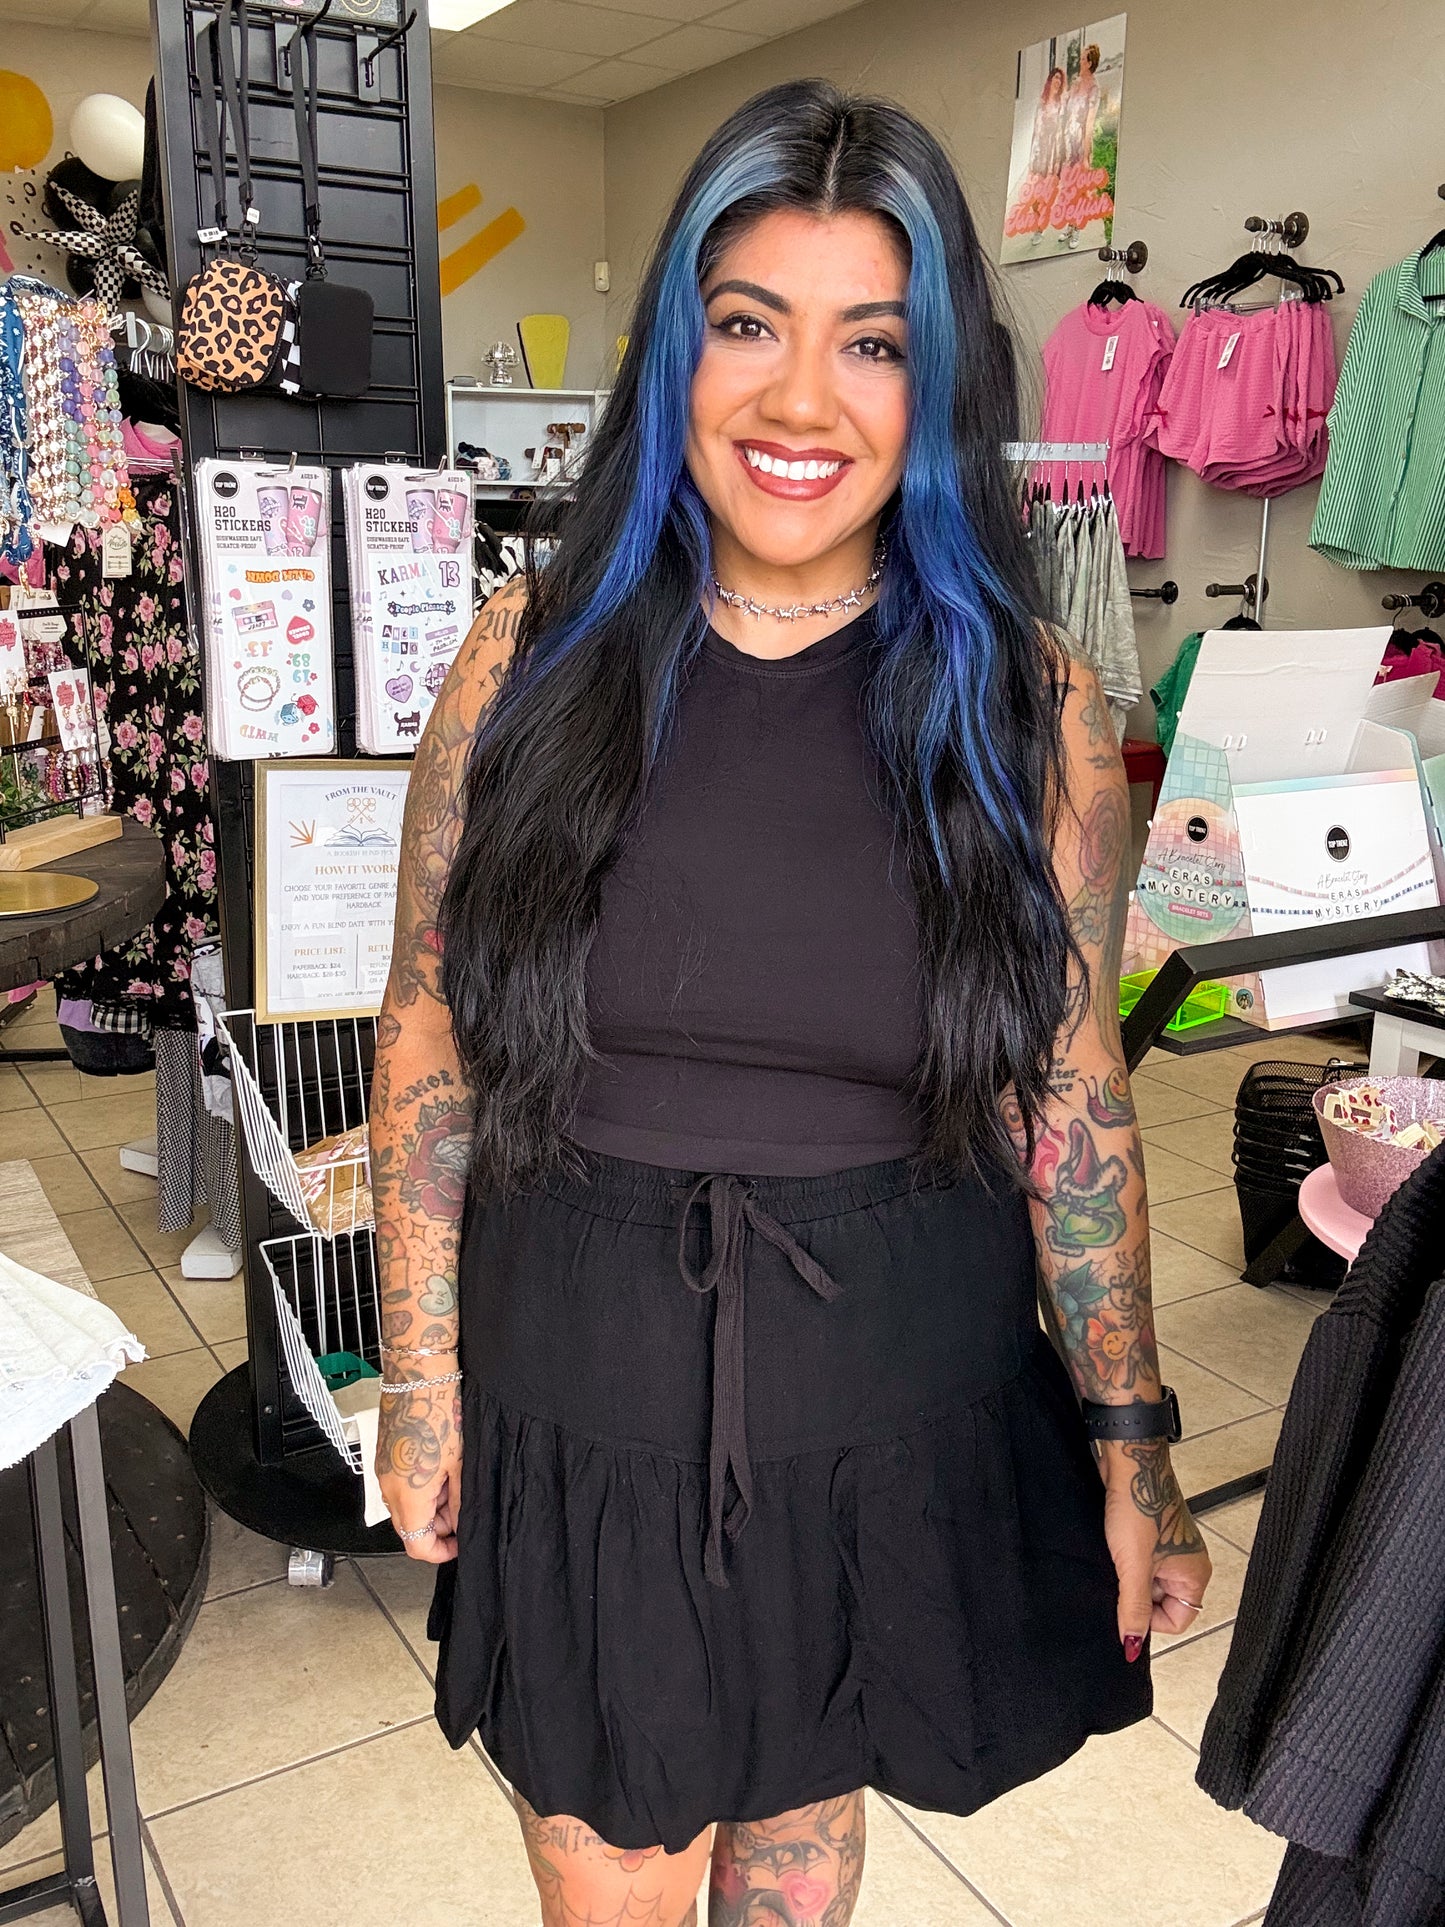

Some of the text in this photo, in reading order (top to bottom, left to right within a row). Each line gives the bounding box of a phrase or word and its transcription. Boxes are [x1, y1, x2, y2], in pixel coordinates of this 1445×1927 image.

[1019, 163, 1109, 204] Self Love
[215, 520, 272, 532] STICKERS
[366, 521, 418, 533] STICKERS
[245, 569, 315, 583] CALM DOWN
[377, 562, 427, 586] KARMA
[439, 561, 461, 588] 13
[325, 787, 350, 801] FROM
[371, 787, 398, 801] VAULT
[1168, 849, 1205, 864] Bracelet
[315, 864, 397, 875] HOW IT WORK
[1171, 870, 1211, 885] ERAS
[284, 884, 312, 892] CHOOSE
[334, 883, 366, 891] FAVORITE
[368, 882, 390, 890] GENRE
[1148, 881, 1231, 905] MYSTERY
[332, 892, 371, 900] PREFERENCE
[1331, 889, 1361, 901] ERAS
[346, 901, 383, 909] HARDBACK
[1314, 899, 1379, 919] MYSTERY
[281, 923, 301, 932] ENJOY
[328, 921, 347, 929] BLIND
[294, 946, 346, 956] PRICE LIST:
[368, 944, 390, 953] RETU
